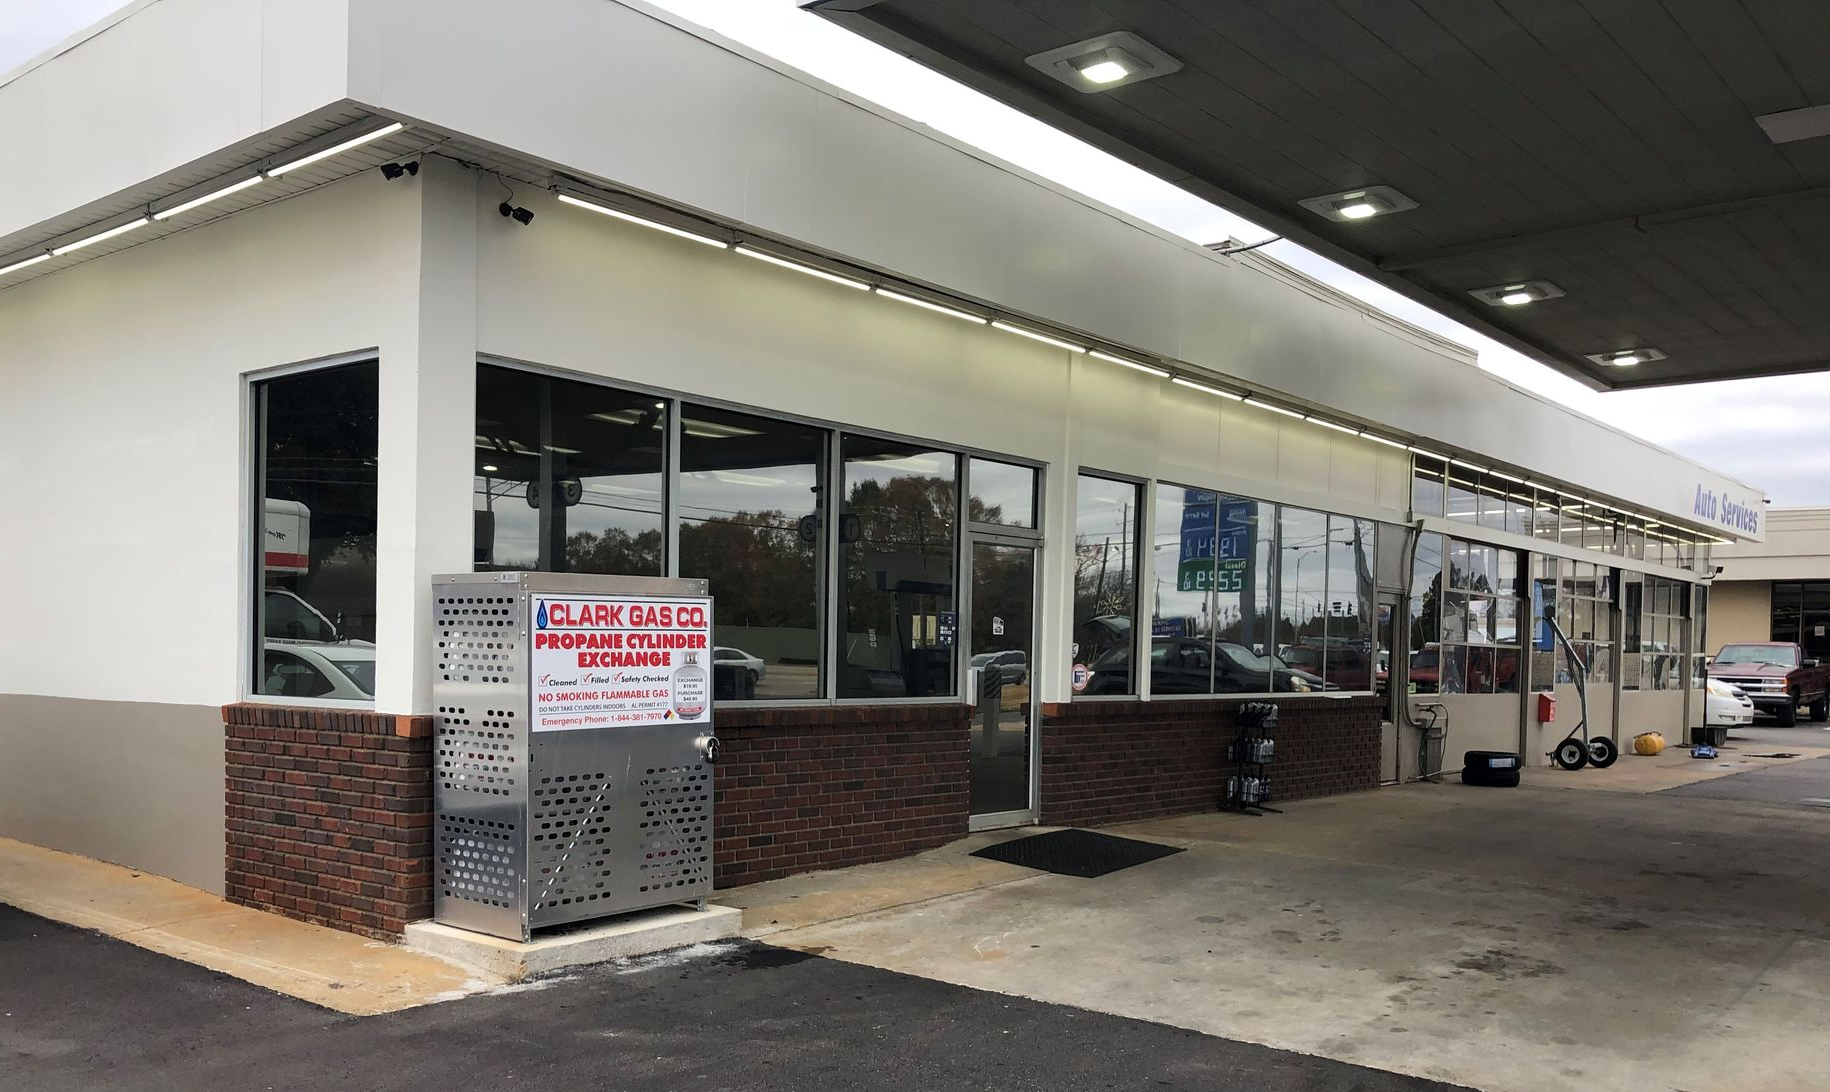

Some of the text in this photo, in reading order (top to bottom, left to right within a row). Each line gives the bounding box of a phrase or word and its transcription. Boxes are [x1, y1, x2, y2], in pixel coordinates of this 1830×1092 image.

[1694, 483, 1758, 534] Auto Services
[549, 603, 708, 628] CLARK GAS CO.
[535, 633, 707, 650] PROPANE CYLINDER
[578, 651, 671, 667] EXCHANGE
[549, 679, 578, 687] Cleaned
[591, 676, 610, 684] Filled
[621, 675, 670, 684] Safety Checked
[538, 689, 669, 702] NO SMOKING FLAMMABLE GAS
[548, 705, 560, 713] NOT
[574, 703, 602, 711] CYLINDERS
[603, 702, 626, 710] INDOORS
[541, 712, 662, 727] Emergency Phone: 1-844-381-7970
